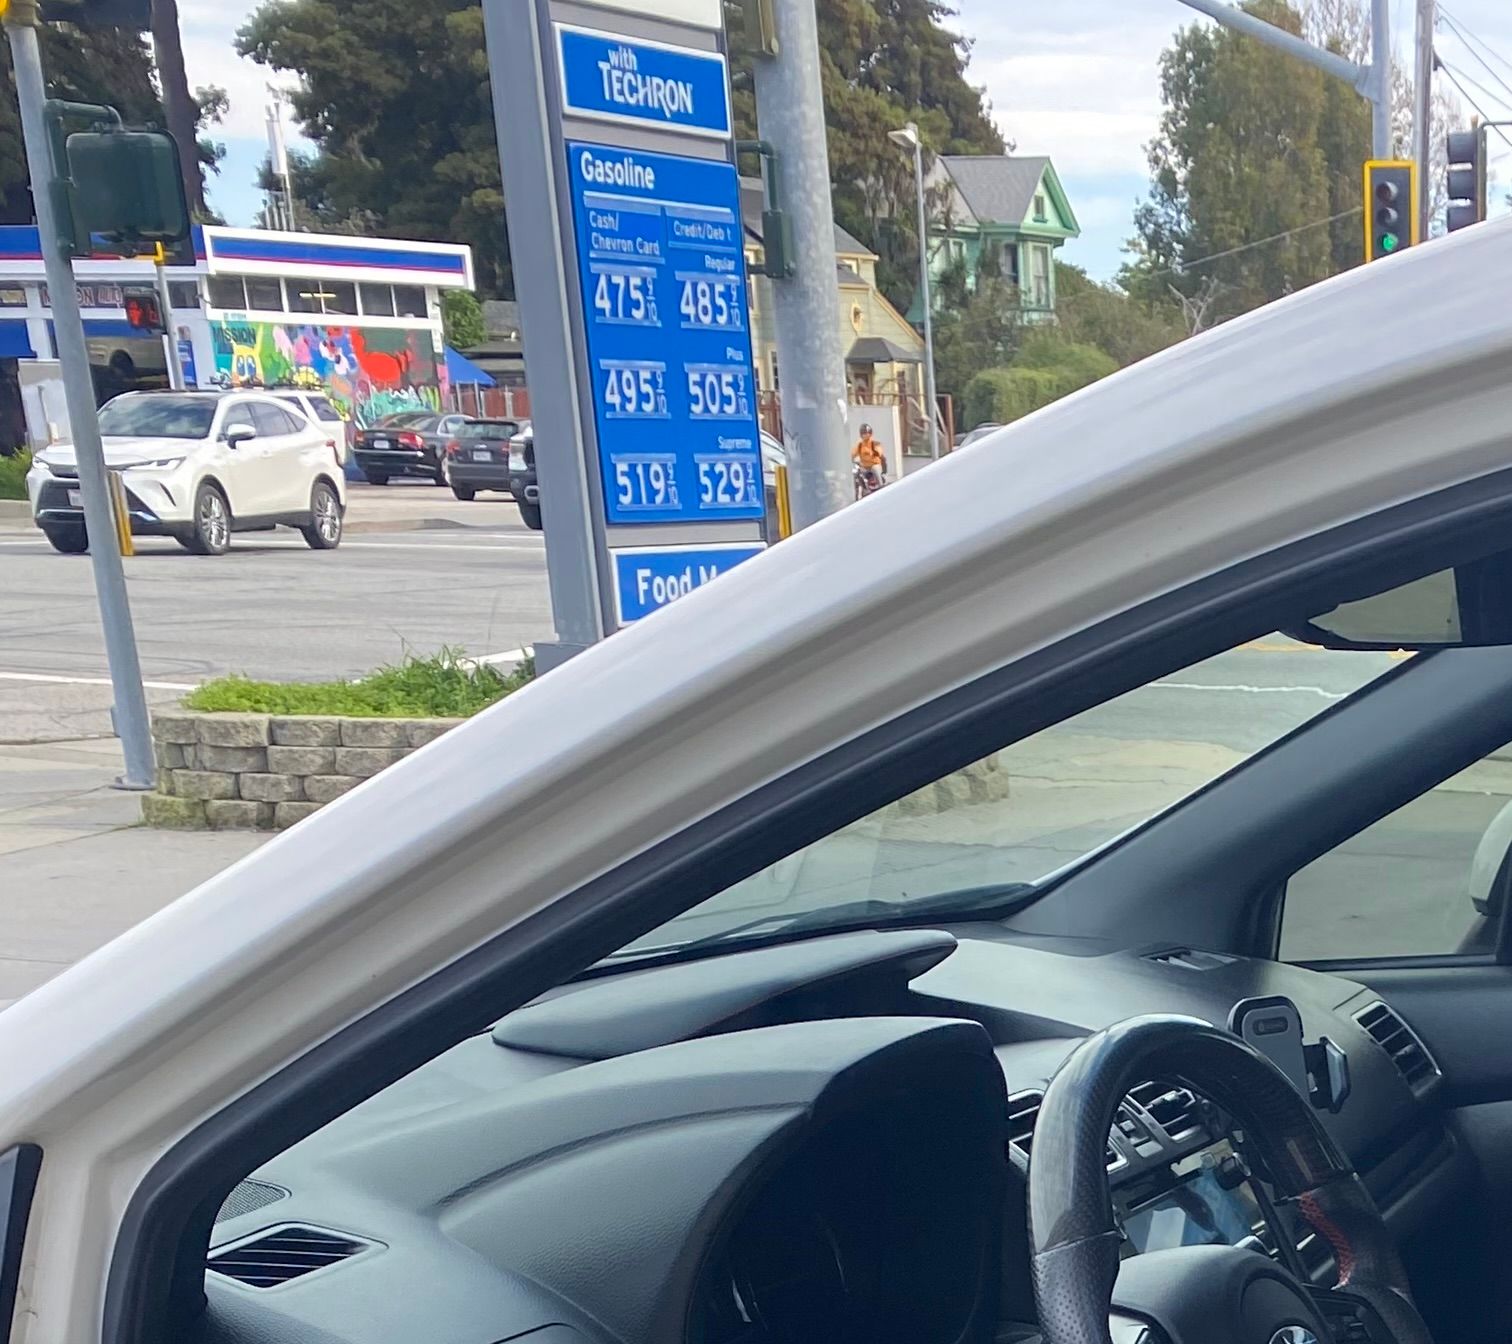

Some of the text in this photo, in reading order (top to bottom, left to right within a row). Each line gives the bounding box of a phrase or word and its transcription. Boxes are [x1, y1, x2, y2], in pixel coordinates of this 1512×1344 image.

[608, 46, 637, 71] with
[598, 61, 693, 119] TECHRON
[581, 151, 655, 190] Gasoline
[589, 210, 619, 231] Cash/
[674, 221, 732, 241] Credit/Debt
[591, 232, 660, 256] Chevron Card
[705, 255, 736, 272] Regular
[595, 273, 645, 320] 475
[680, 280, 728, 325] 485
[726, 347, 744, 361] Plus
[605, 369, 654, 413] 495
[688, 372, 736, 414] 505
[616, 463, 664, 505] 519
[699, 462, 744, 503] 529
[637, 566, 692, 605] Food
